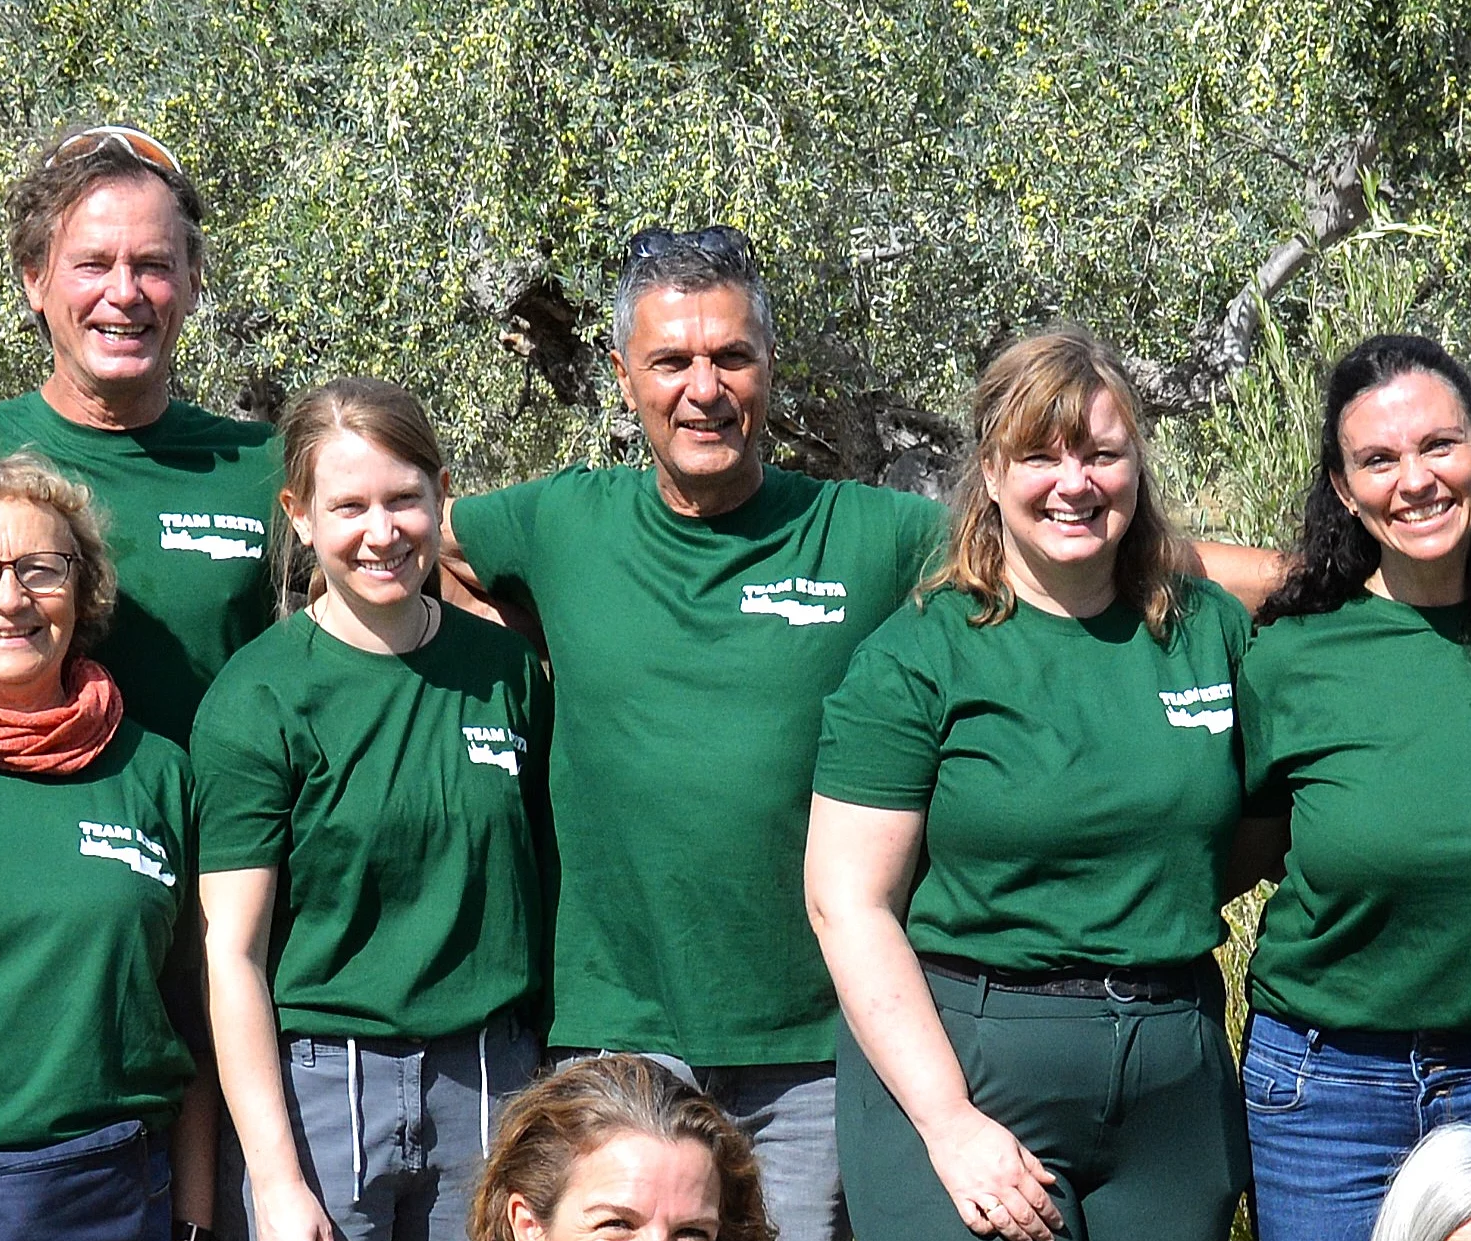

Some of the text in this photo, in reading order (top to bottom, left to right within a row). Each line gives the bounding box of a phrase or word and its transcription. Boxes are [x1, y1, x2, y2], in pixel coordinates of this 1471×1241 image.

[158, 513, 265, 535] TEAM KRETA
[742, 577, 847, 597] TEAM KRETA
[1158, 683, 1233, 706] TEAM KRET
[462, 727, 506, 742] TEAM
[79, 821, 132, 840] TEAM
